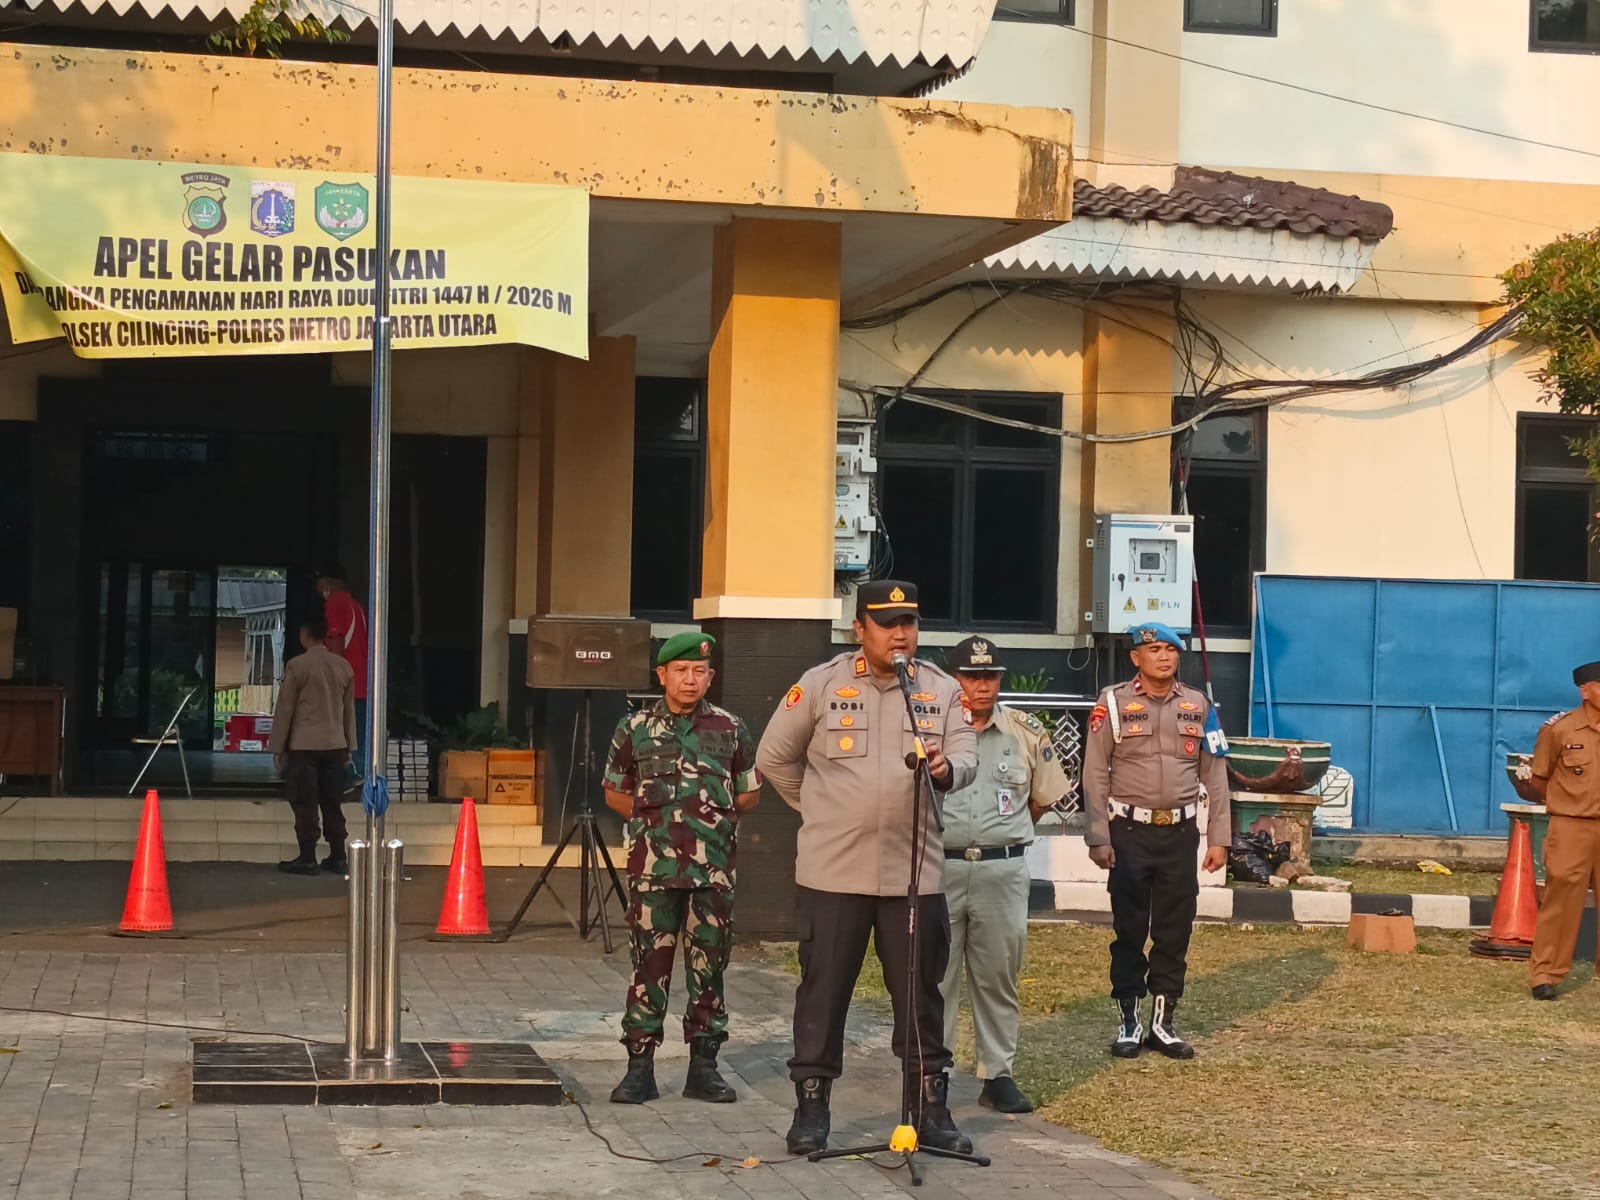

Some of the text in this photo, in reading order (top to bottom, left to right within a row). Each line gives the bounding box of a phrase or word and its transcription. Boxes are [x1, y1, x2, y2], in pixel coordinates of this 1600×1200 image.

[93, 236, 173, 280] APEL
[181, 240, 284, 282] GELAR
[110, 288, 235, 311] PENGAMANAN
[240, 289, 284, 310] HARI
[288, 288, 333, 308] RAYA
[432, 285, 473, 305] 1447
[477, 285, 489, 305] H
[494, 284, 503, 305] /
[506, 285, 553, 310] 2026
[557, 292, 572, 316] M
[62, 321, 113, 348] OLSEK
[289, 315, 351, 343] METRO
[355, 313, 435, 341] JAARTA
[438, 312, 498, 338] UTARA
[830, 702, 864, 711] BOBI
[913, 705, 941, 715] OLRI
[1177, 712, 1202, 722] POLRI
